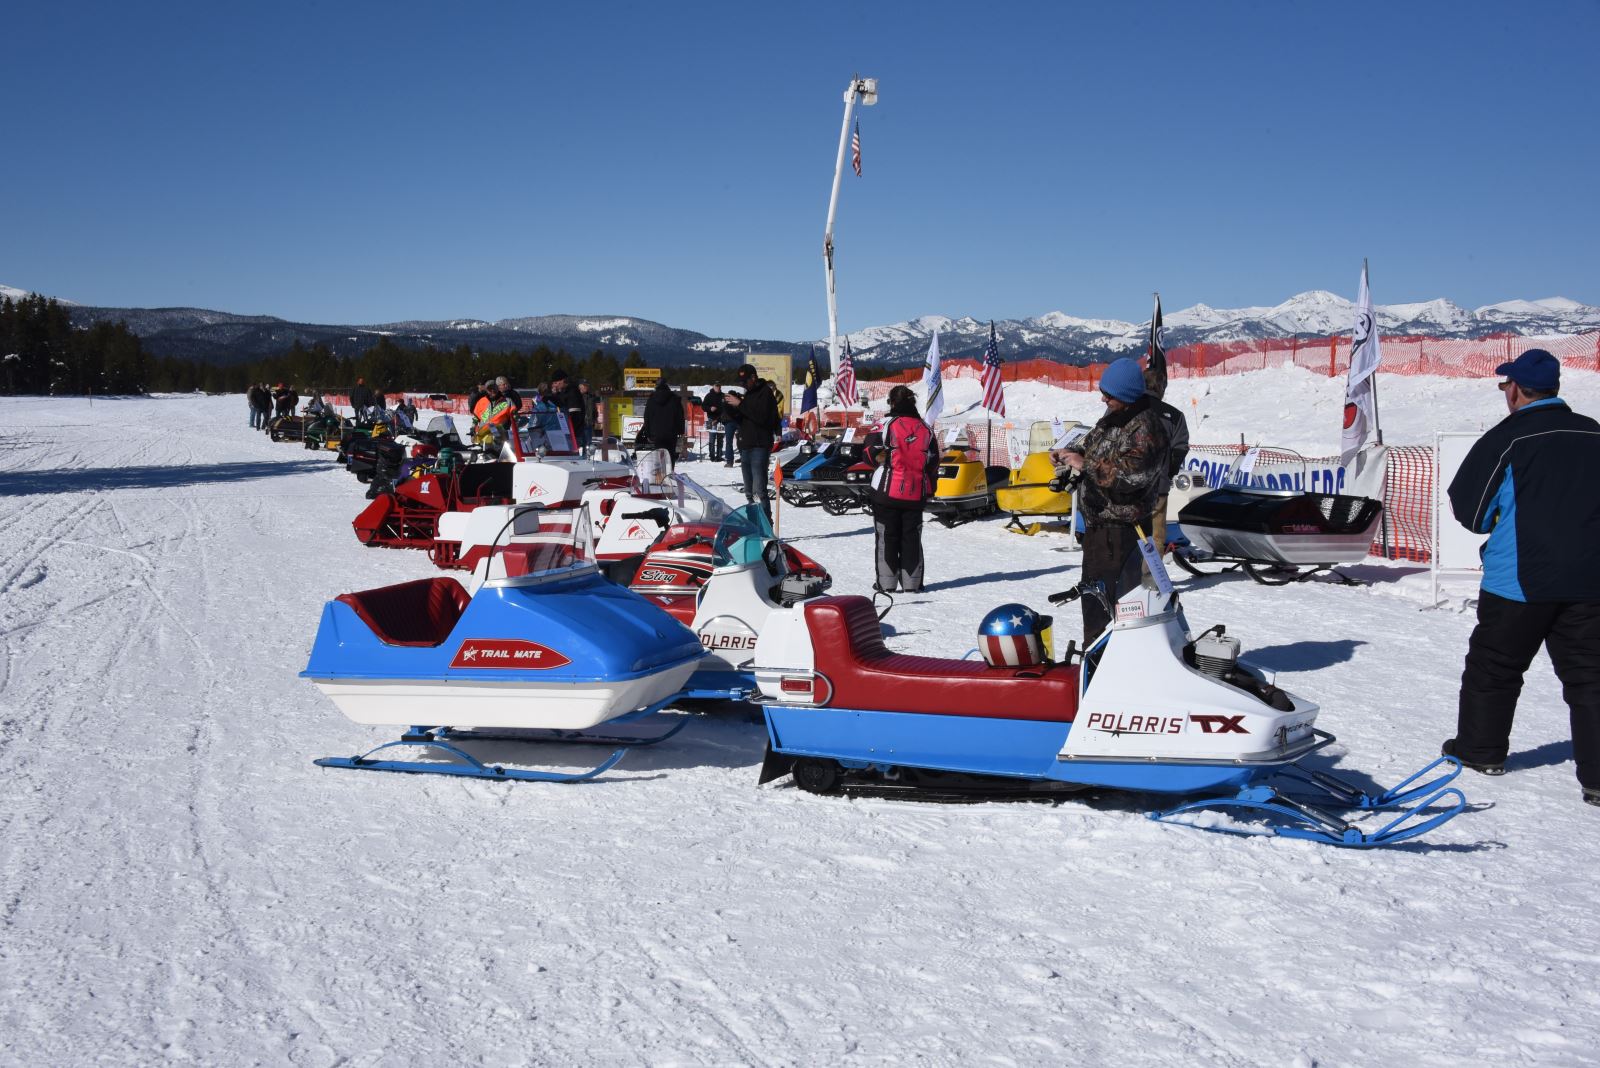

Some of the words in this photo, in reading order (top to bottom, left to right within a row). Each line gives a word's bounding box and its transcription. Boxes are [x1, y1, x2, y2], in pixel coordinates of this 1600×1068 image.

[640, 569, 677, 583] Sting
[698, 632, 757, 649] OLARIS
[480, 649, 510, 658] TRAIL
[513, 650, 542, 659] MATE
[1087, 711, 1185, 734] POLARIS
[1190, 714, 1251, 734] TX
